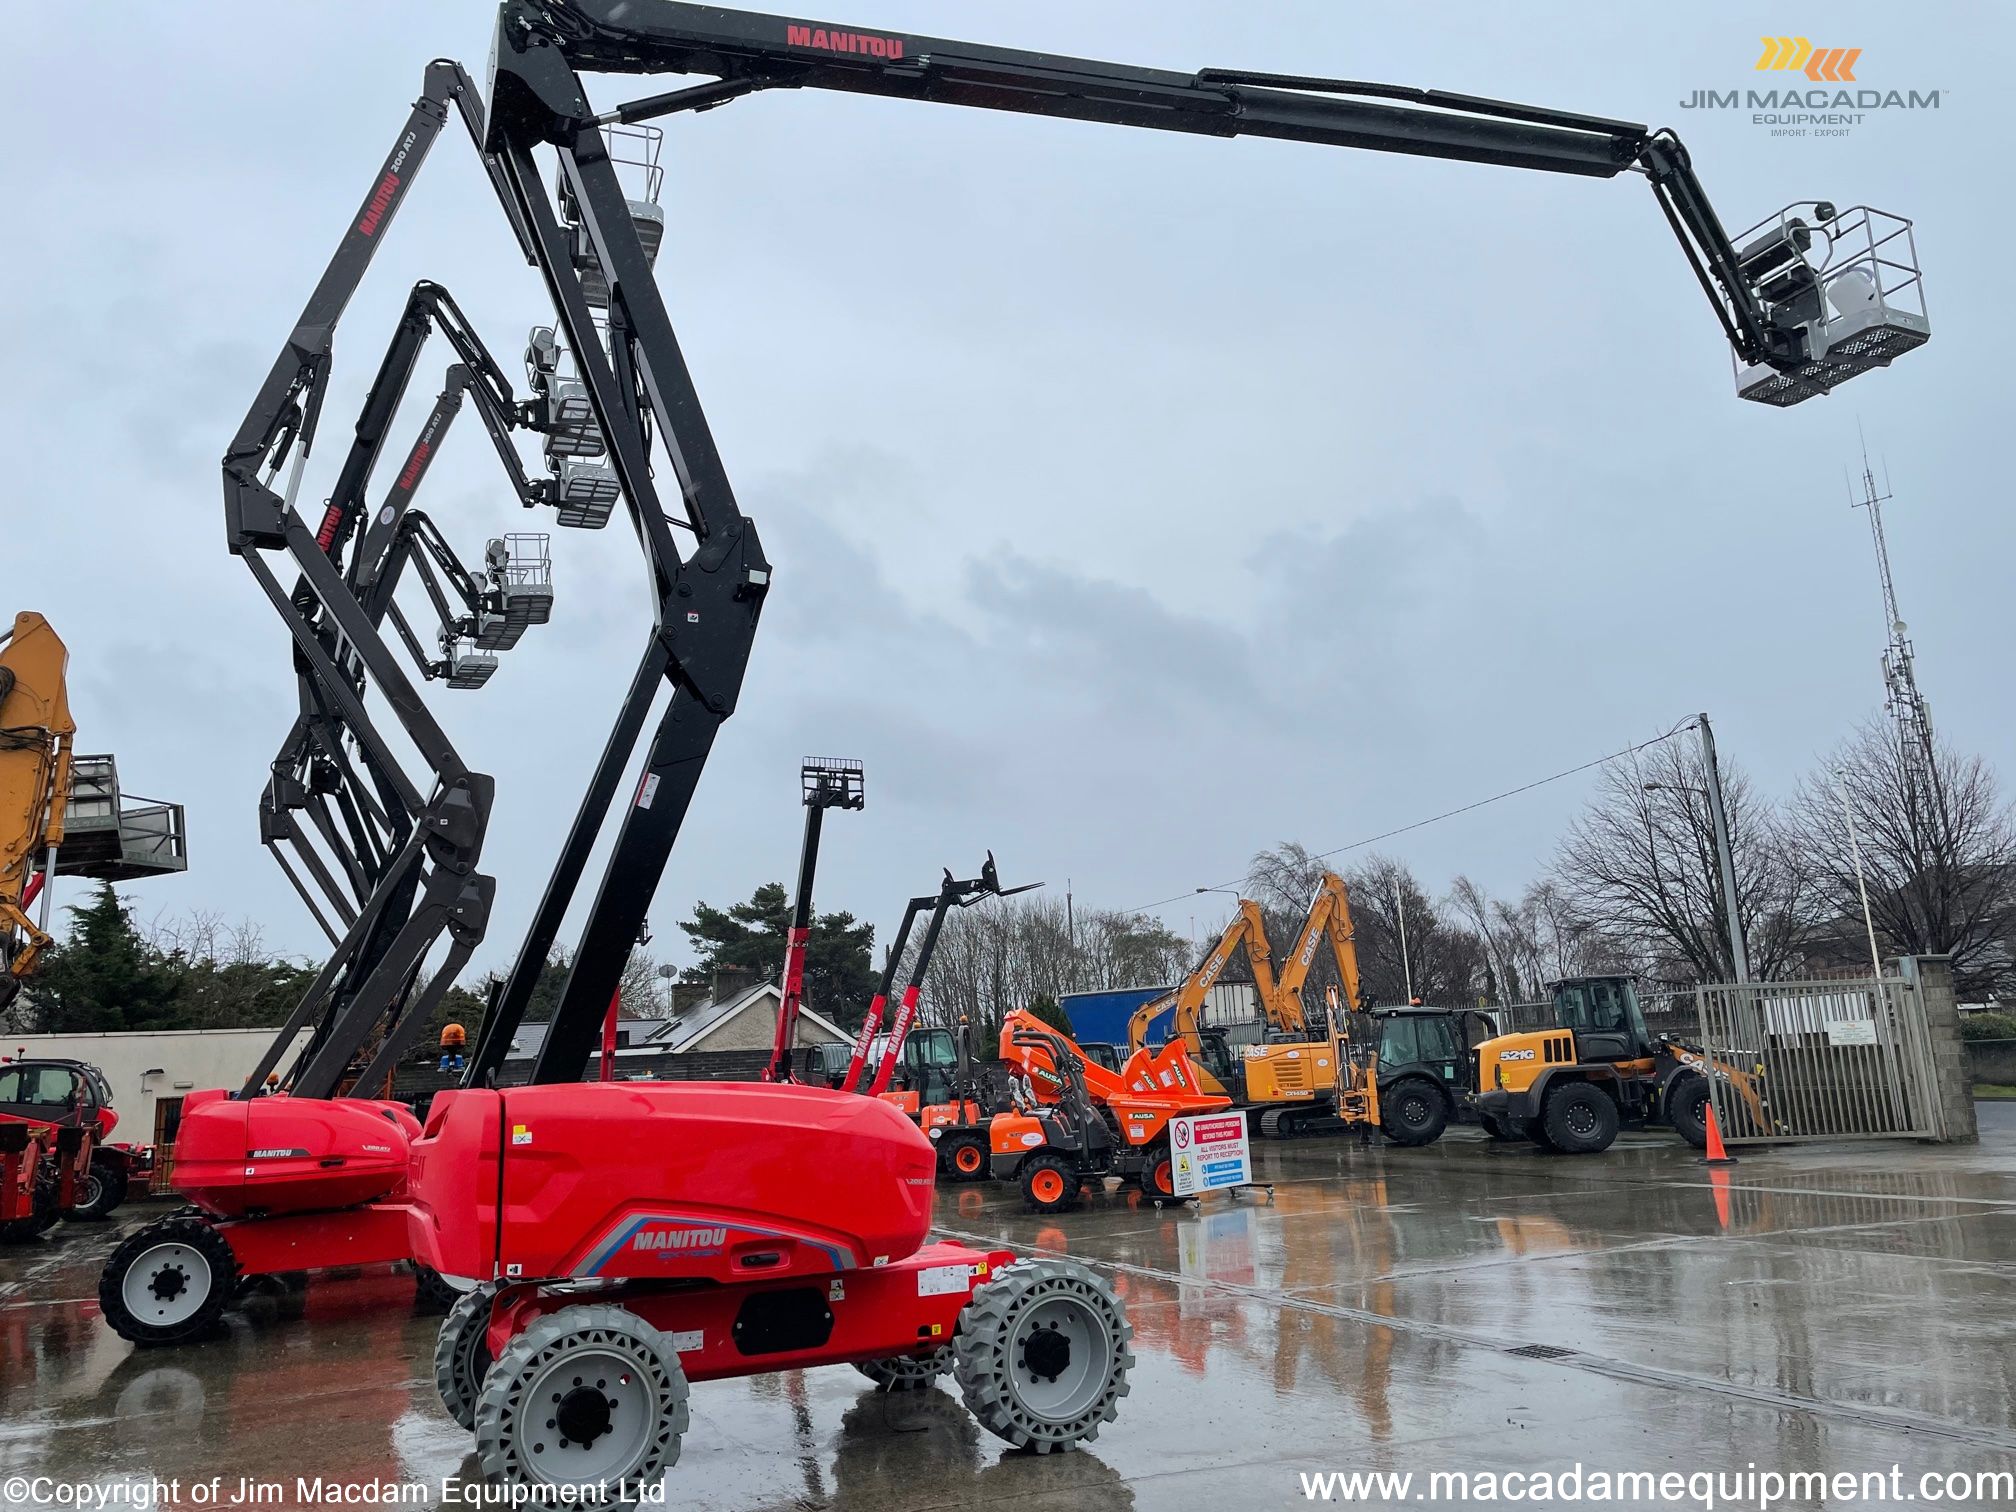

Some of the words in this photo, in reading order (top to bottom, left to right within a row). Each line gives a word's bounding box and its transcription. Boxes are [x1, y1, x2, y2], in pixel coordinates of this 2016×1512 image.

[787, 25, 903, 60] MANITOU
[359, 171, 400, 237] MANITOU
[390, 150, 407, 173] 200
[403, 131, 417, 152] ATJ
[400, 442, 430, 490] MANITOU
[432, 413, 442, 433] ATJ
[1301, 926, 1320, 967] CASE
[1199, 953, 1225, 988] CASE
[1155, 997, 1177, 1012] CASE
[855, 1012, 878, 1059] MANITOU
[887, 1004, 911, 1055] MANITOU
[1245, 1046, 1269, 1058] CASE
[1500, 1049, 1535, 1061] 521G
[1038, 1069, 1063, 1085] AUSA
[1173, 1063, 1186, 1087] AUSA
[633, 1228, 727, 1251] MANITOU
